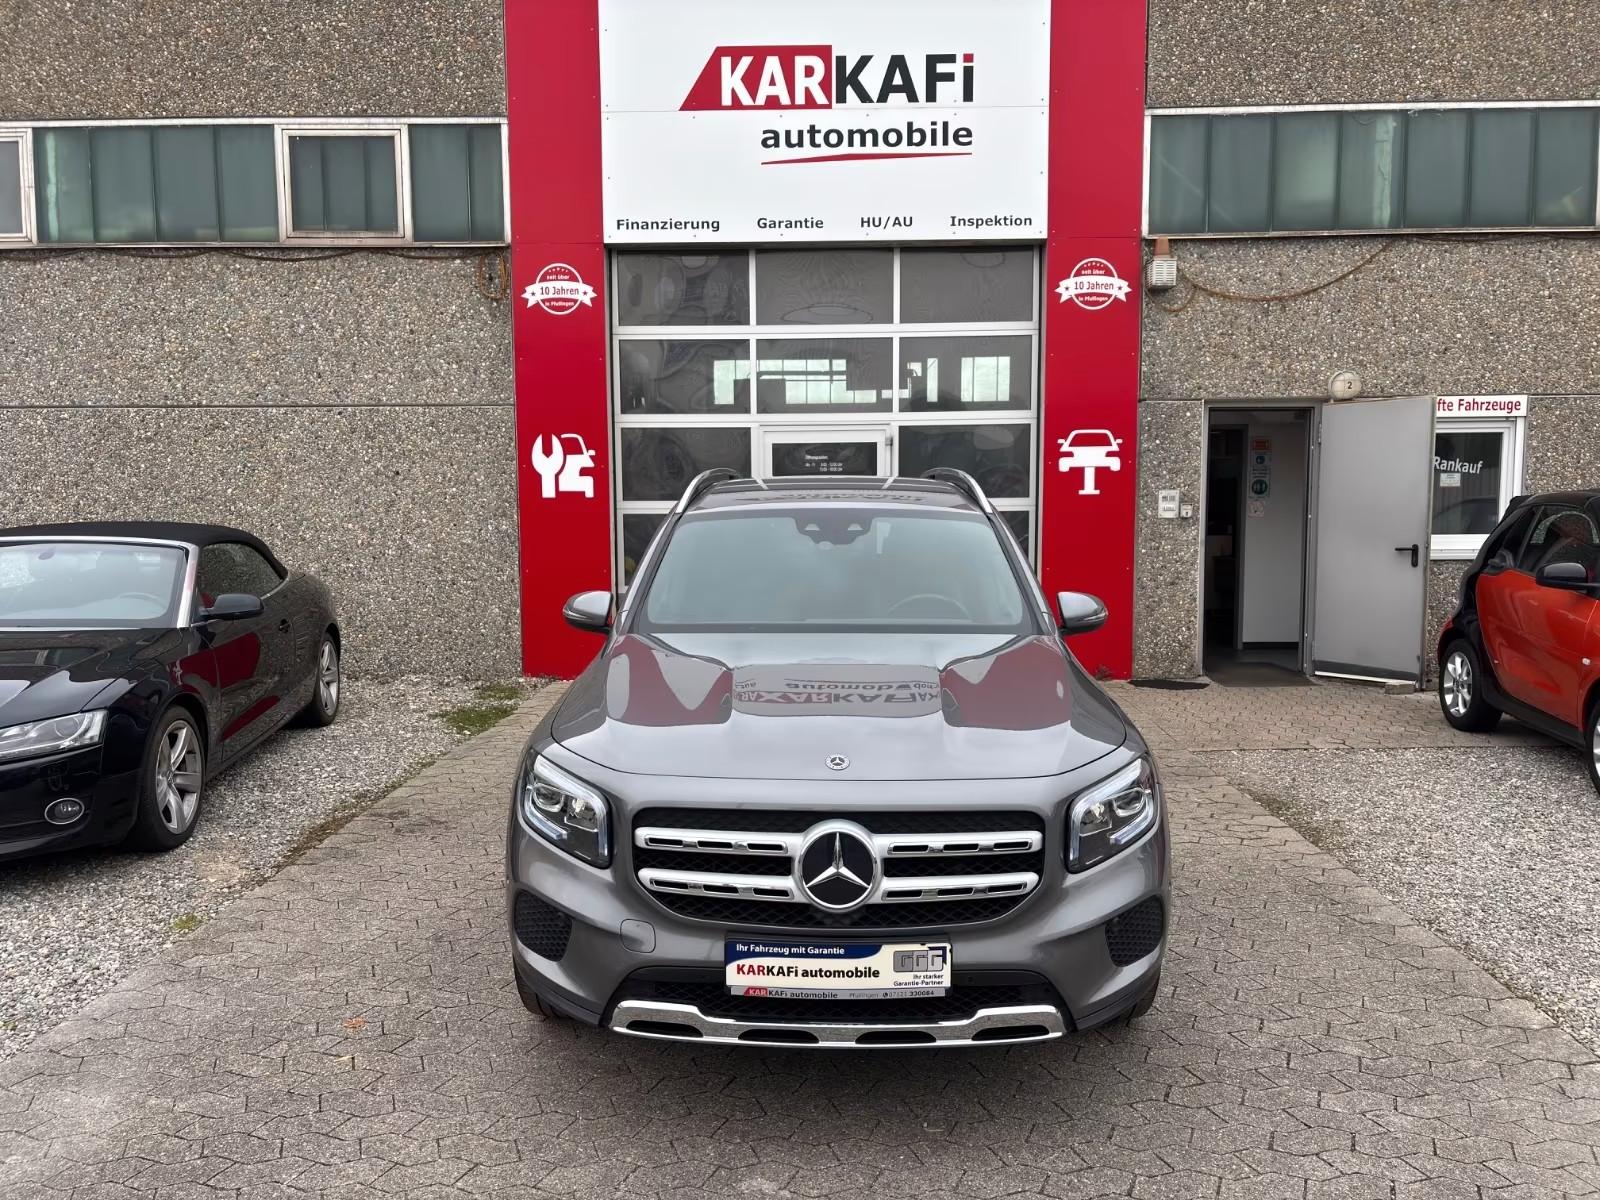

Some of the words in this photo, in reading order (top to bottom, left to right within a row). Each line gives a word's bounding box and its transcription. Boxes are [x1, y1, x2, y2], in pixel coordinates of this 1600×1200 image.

[720, 53, 974, 106] KARKAFi
[760, 121, 973, 149] automobile
[616, 217, 720, 232] Finanzierung
[757, 216, 824, 229] Garantie
[860, 215, 913, 229] HU/AU
[949, 214, 1033, 230] Inspektion
[540, 286, 550, 296] 10
[552, 286, 579, 296] Jahren
[1074, 281, 1084, 290] 10
[1086, 281, 1114, 290] Jahren
[1347, 381, 1353, 390] 2
[1458, 398, 1521, 414] Fahrzeuge
[736, 943, 748, 952] Ihr
[750, 944, 789, 955] Fahrzeug
[791, 945, 806, 954] mit
[808, 946, 845, 955] Garantie
[736, 964, 799, 977] KARKAFi
[801, 966, 880, 978] automobile
[790, 989, 838, 999] automobile
